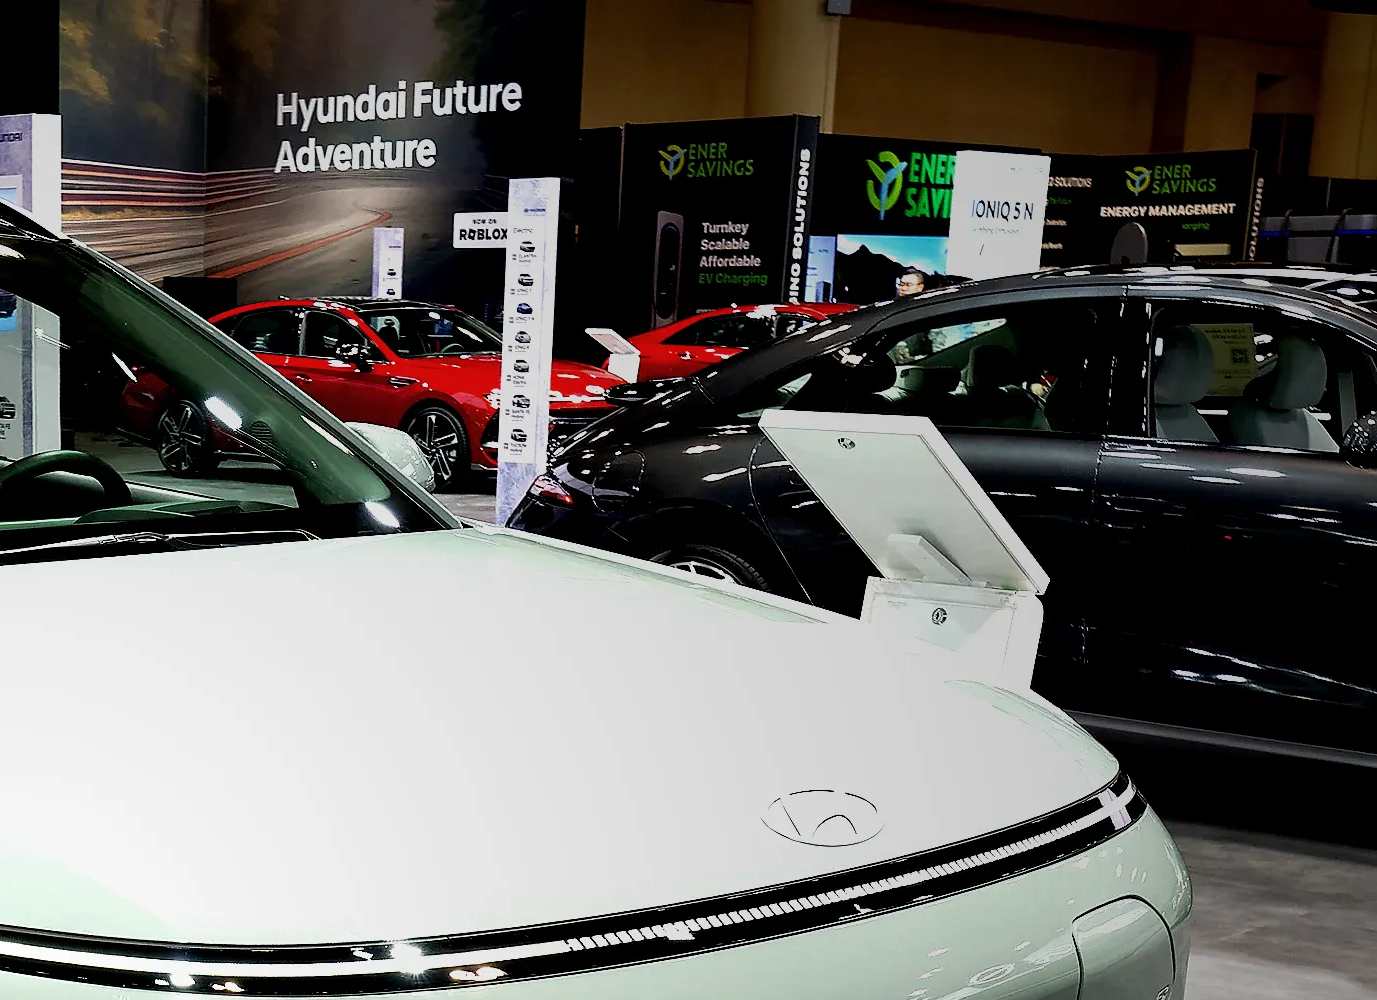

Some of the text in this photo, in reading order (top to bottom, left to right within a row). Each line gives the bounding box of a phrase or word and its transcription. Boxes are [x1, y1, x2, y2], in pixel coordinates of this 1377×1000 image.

[276, 80, 523, 132] Hyundai Future
[274, 136, 437, 174] Adventure
[688, 142, 728, 160] ENER
[687, 159, 754, 178] SAVINGS
[1153, 164, 1192, 179] ENER
[1151, 178, 1217, 194] SAVINGS
[792, 148, 811, 260] SOLUTIONS
[971, 199, 1034, 222] IONIQ 5 N
[1100, 203, 1237, 218] ENERGY MANAGEMENT
[459, 228, 508, 241] ROBLOX
[702, 221, 749, 235] Turnkey
[700, 238, 750, 250] Scalable
[699, 255, 761, 267] Affordable
[698, 273, 768, 286] EV Charging
